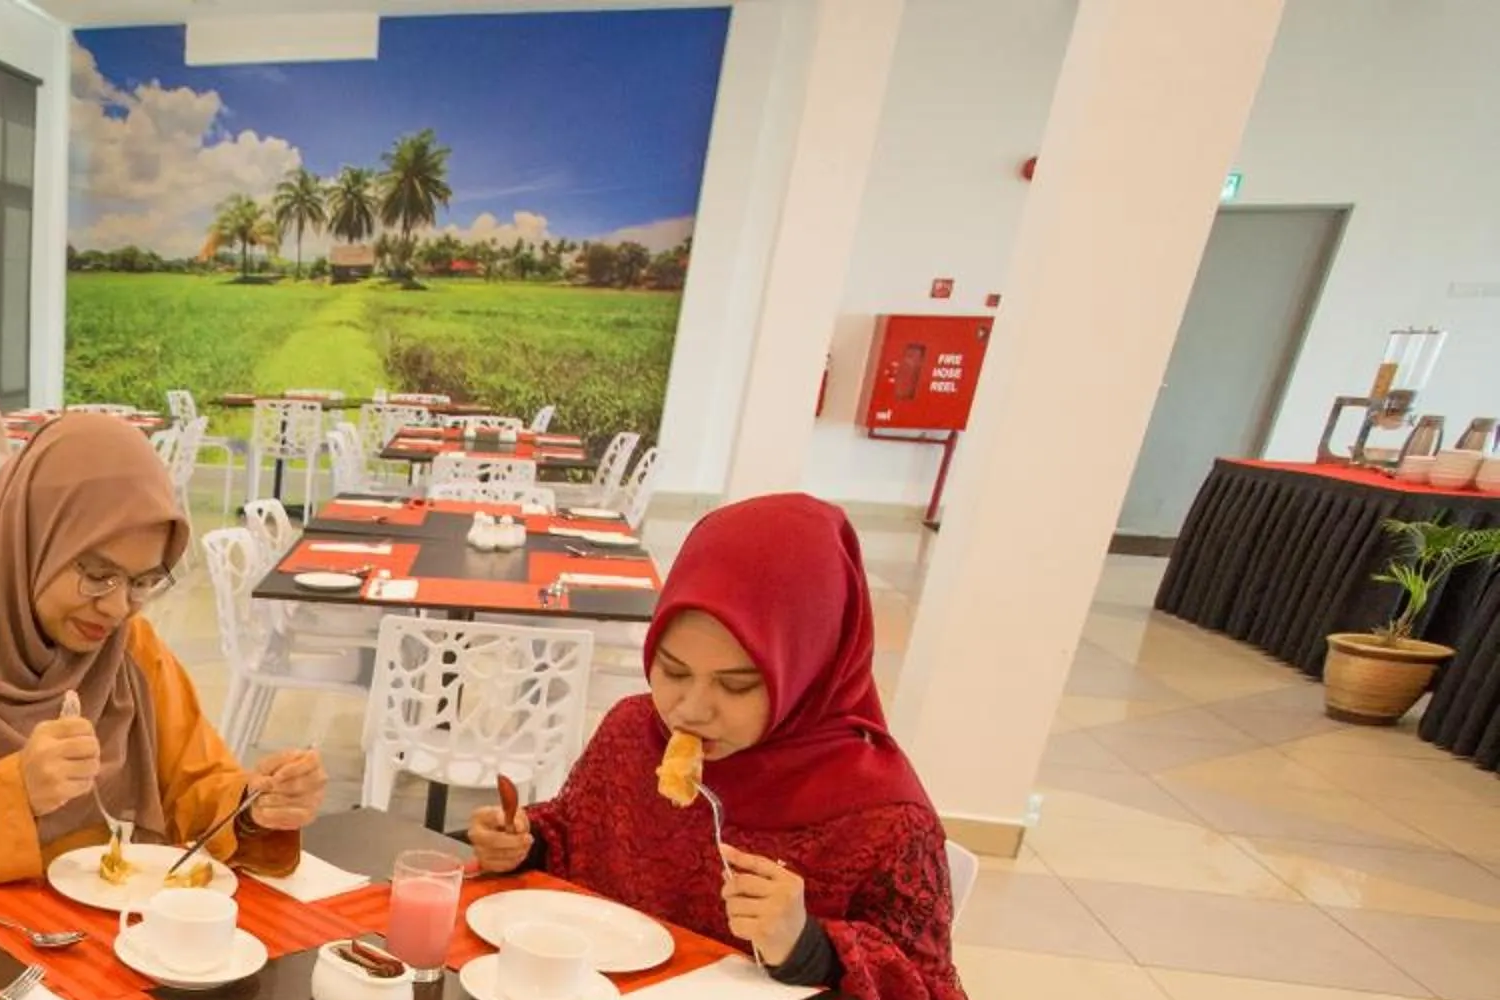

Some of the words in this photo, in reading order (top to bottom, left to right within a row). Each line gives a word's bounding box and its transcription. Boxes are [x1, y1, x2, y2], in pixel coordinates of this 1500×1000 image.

[937, 353, 964, 366] FIRE
[932, 367, 962, 379] HOSE
[929, 381, 958, 393] REEL
